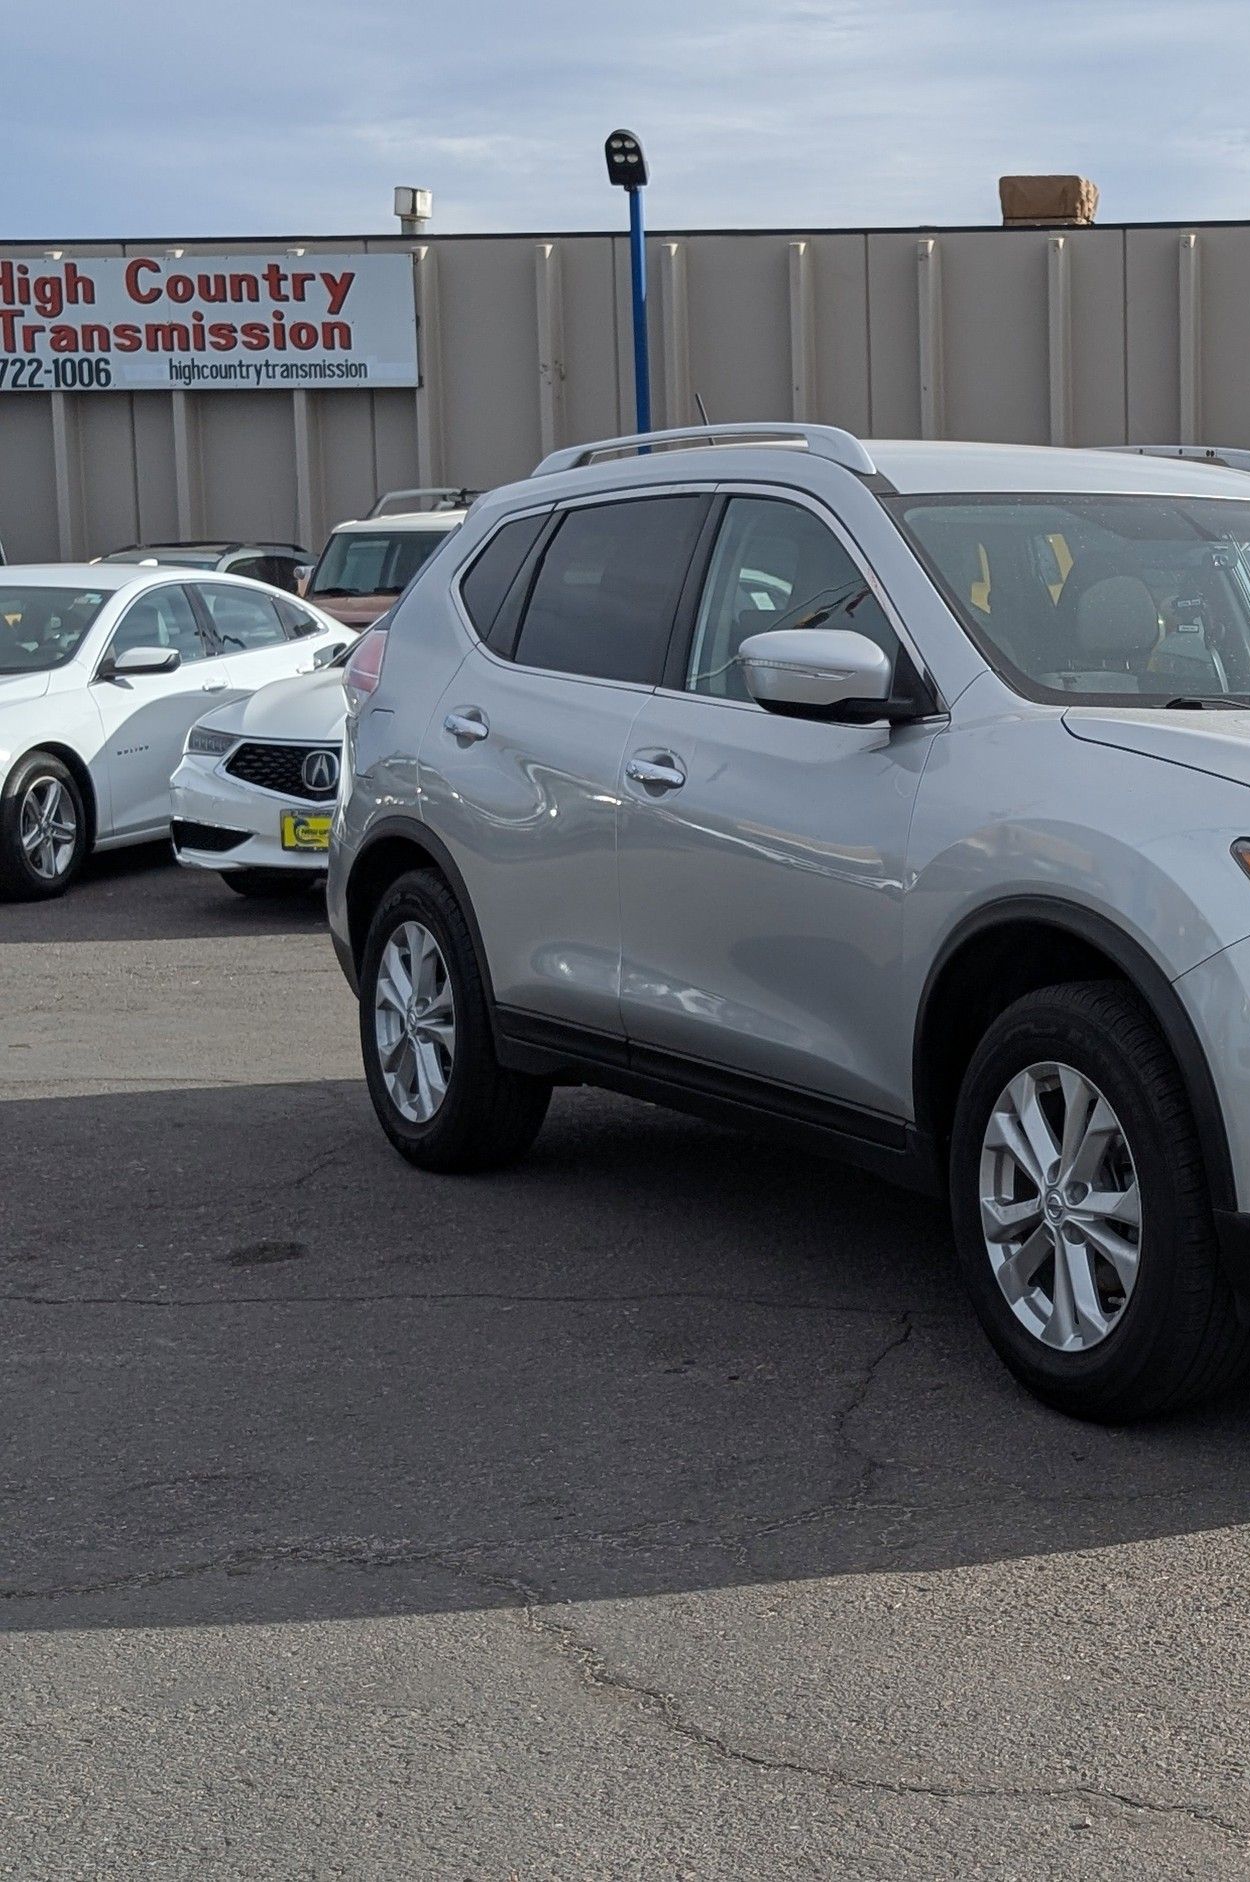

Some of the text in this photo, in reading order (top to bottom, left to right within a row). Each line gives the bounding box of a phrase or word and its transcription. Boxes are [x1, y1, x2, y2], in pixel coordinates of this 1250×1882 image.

[126, 258, 355, 314] Country
[0, 310, 353, 354] Transmission
[0, 357, 368, 388] 722-1006 highcountrytransmission
